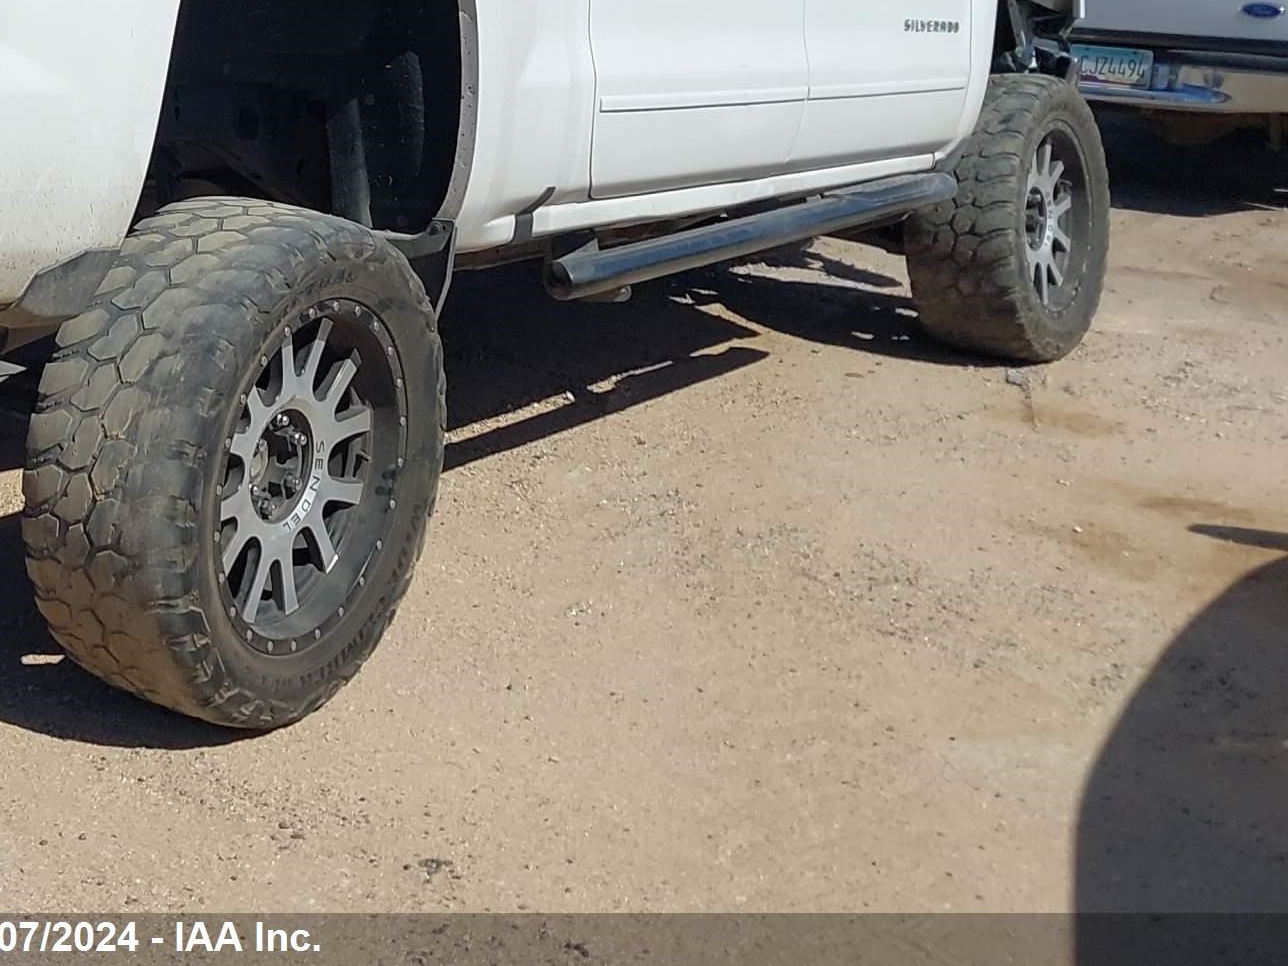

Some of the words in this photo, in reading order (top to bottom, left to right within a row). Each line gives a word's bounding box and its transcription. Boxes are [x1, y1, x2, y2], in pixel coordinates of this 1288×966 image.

[903, 18, 960, 34] SILVERADO
[1079, 56, 1145, 78] CJZ4494
[282, 440, 325, 531] SENDEL
